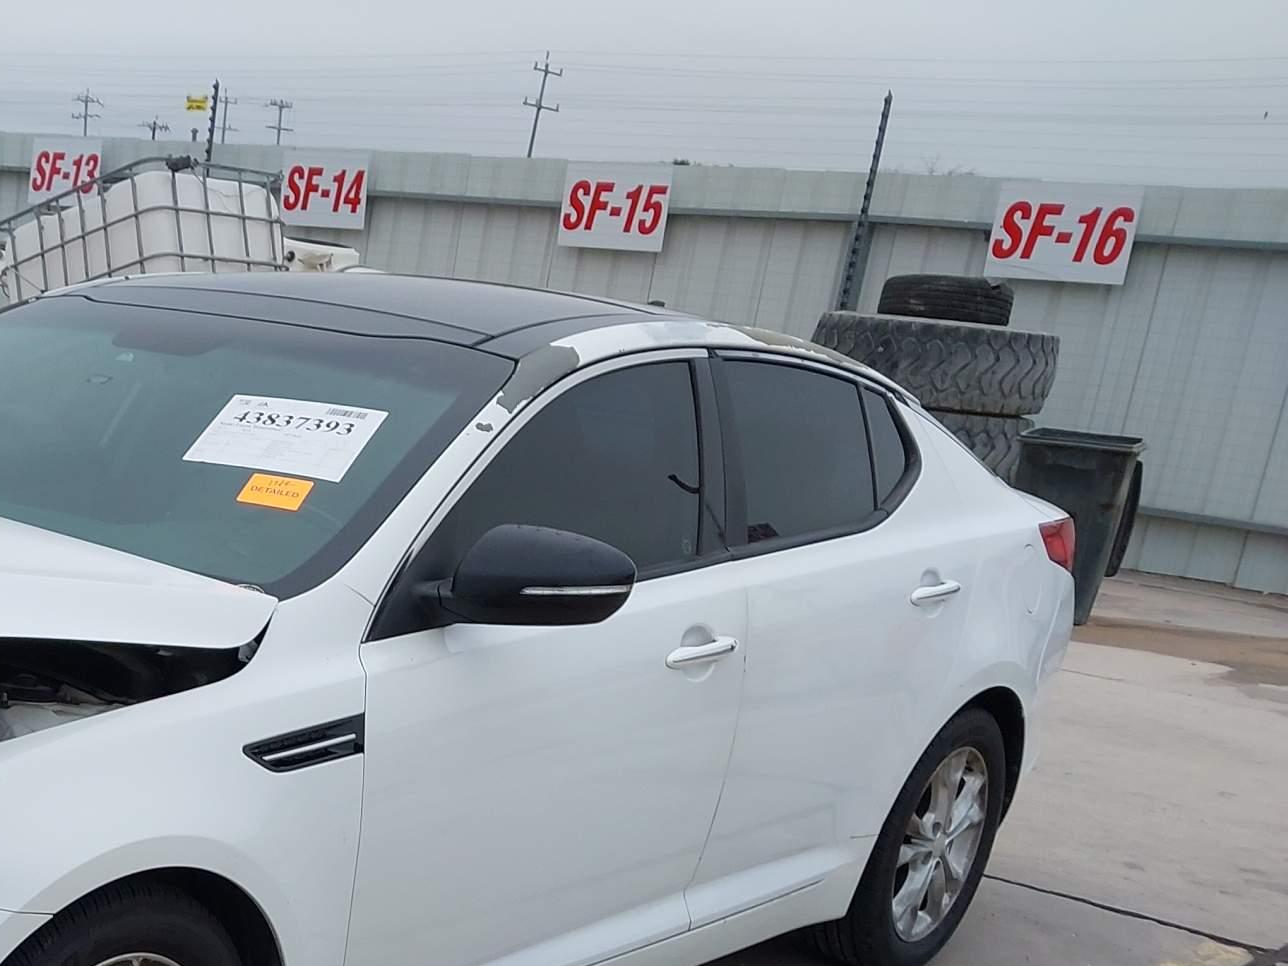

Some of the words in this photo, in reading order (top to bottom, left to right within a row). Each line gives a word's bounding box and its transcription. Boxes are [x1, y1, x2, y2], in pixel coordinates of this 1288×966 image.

[31, 150, 100, 194] SF-13
[282, 164, 366, 214] SF-14
[561, 179, 669, 237] SF-15
[990, 199, 1137, 267] SF-16
[233, 409, 356, 437] 43837393
[250, 484, 300, 498] DETAILED
